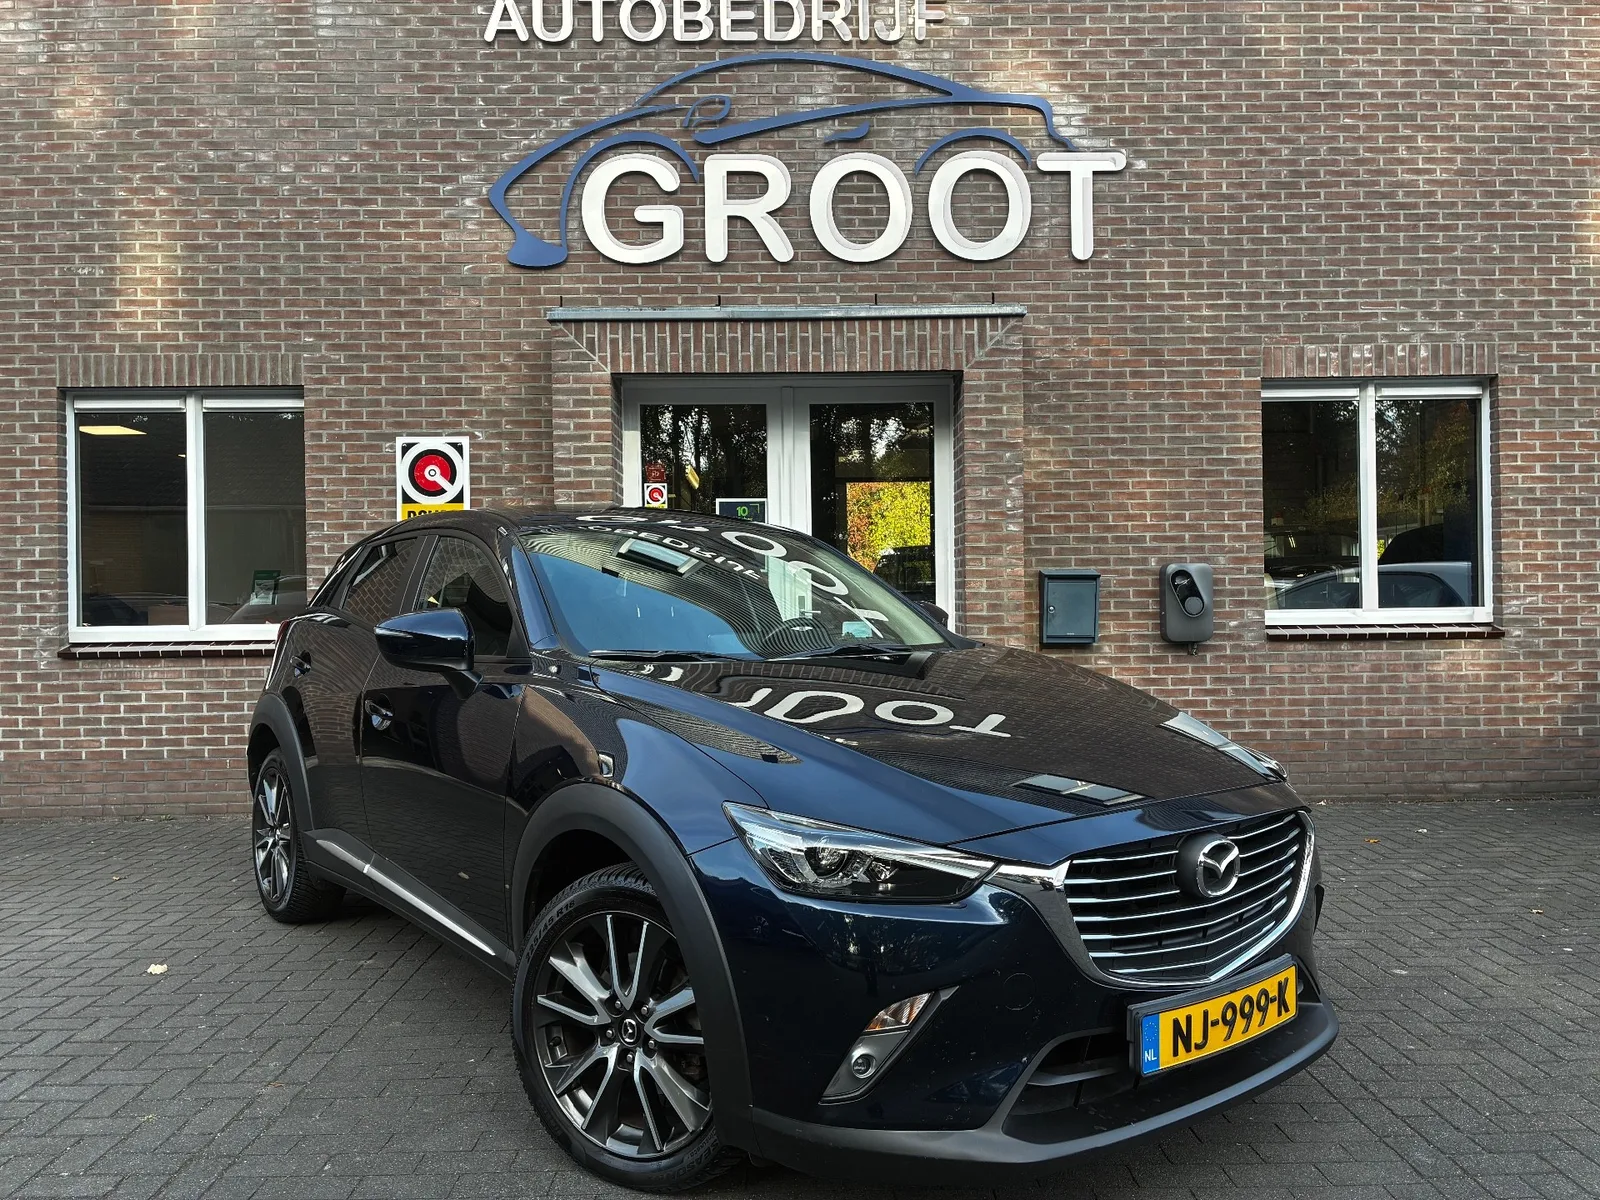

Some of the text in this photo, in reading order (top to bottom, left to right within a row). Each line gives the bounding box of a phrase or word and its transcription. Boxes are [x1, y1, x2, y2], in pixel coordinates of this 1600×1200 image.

[483, 0, 946, 42] AUTOBEDRIJF
[581, 149, 1127, 265] GROOT
[736, 506, 749, 517] 10
[1172, 976, 1291, 1058] NJ-999-K
[1144, 1048, 1158, 1062] NL
